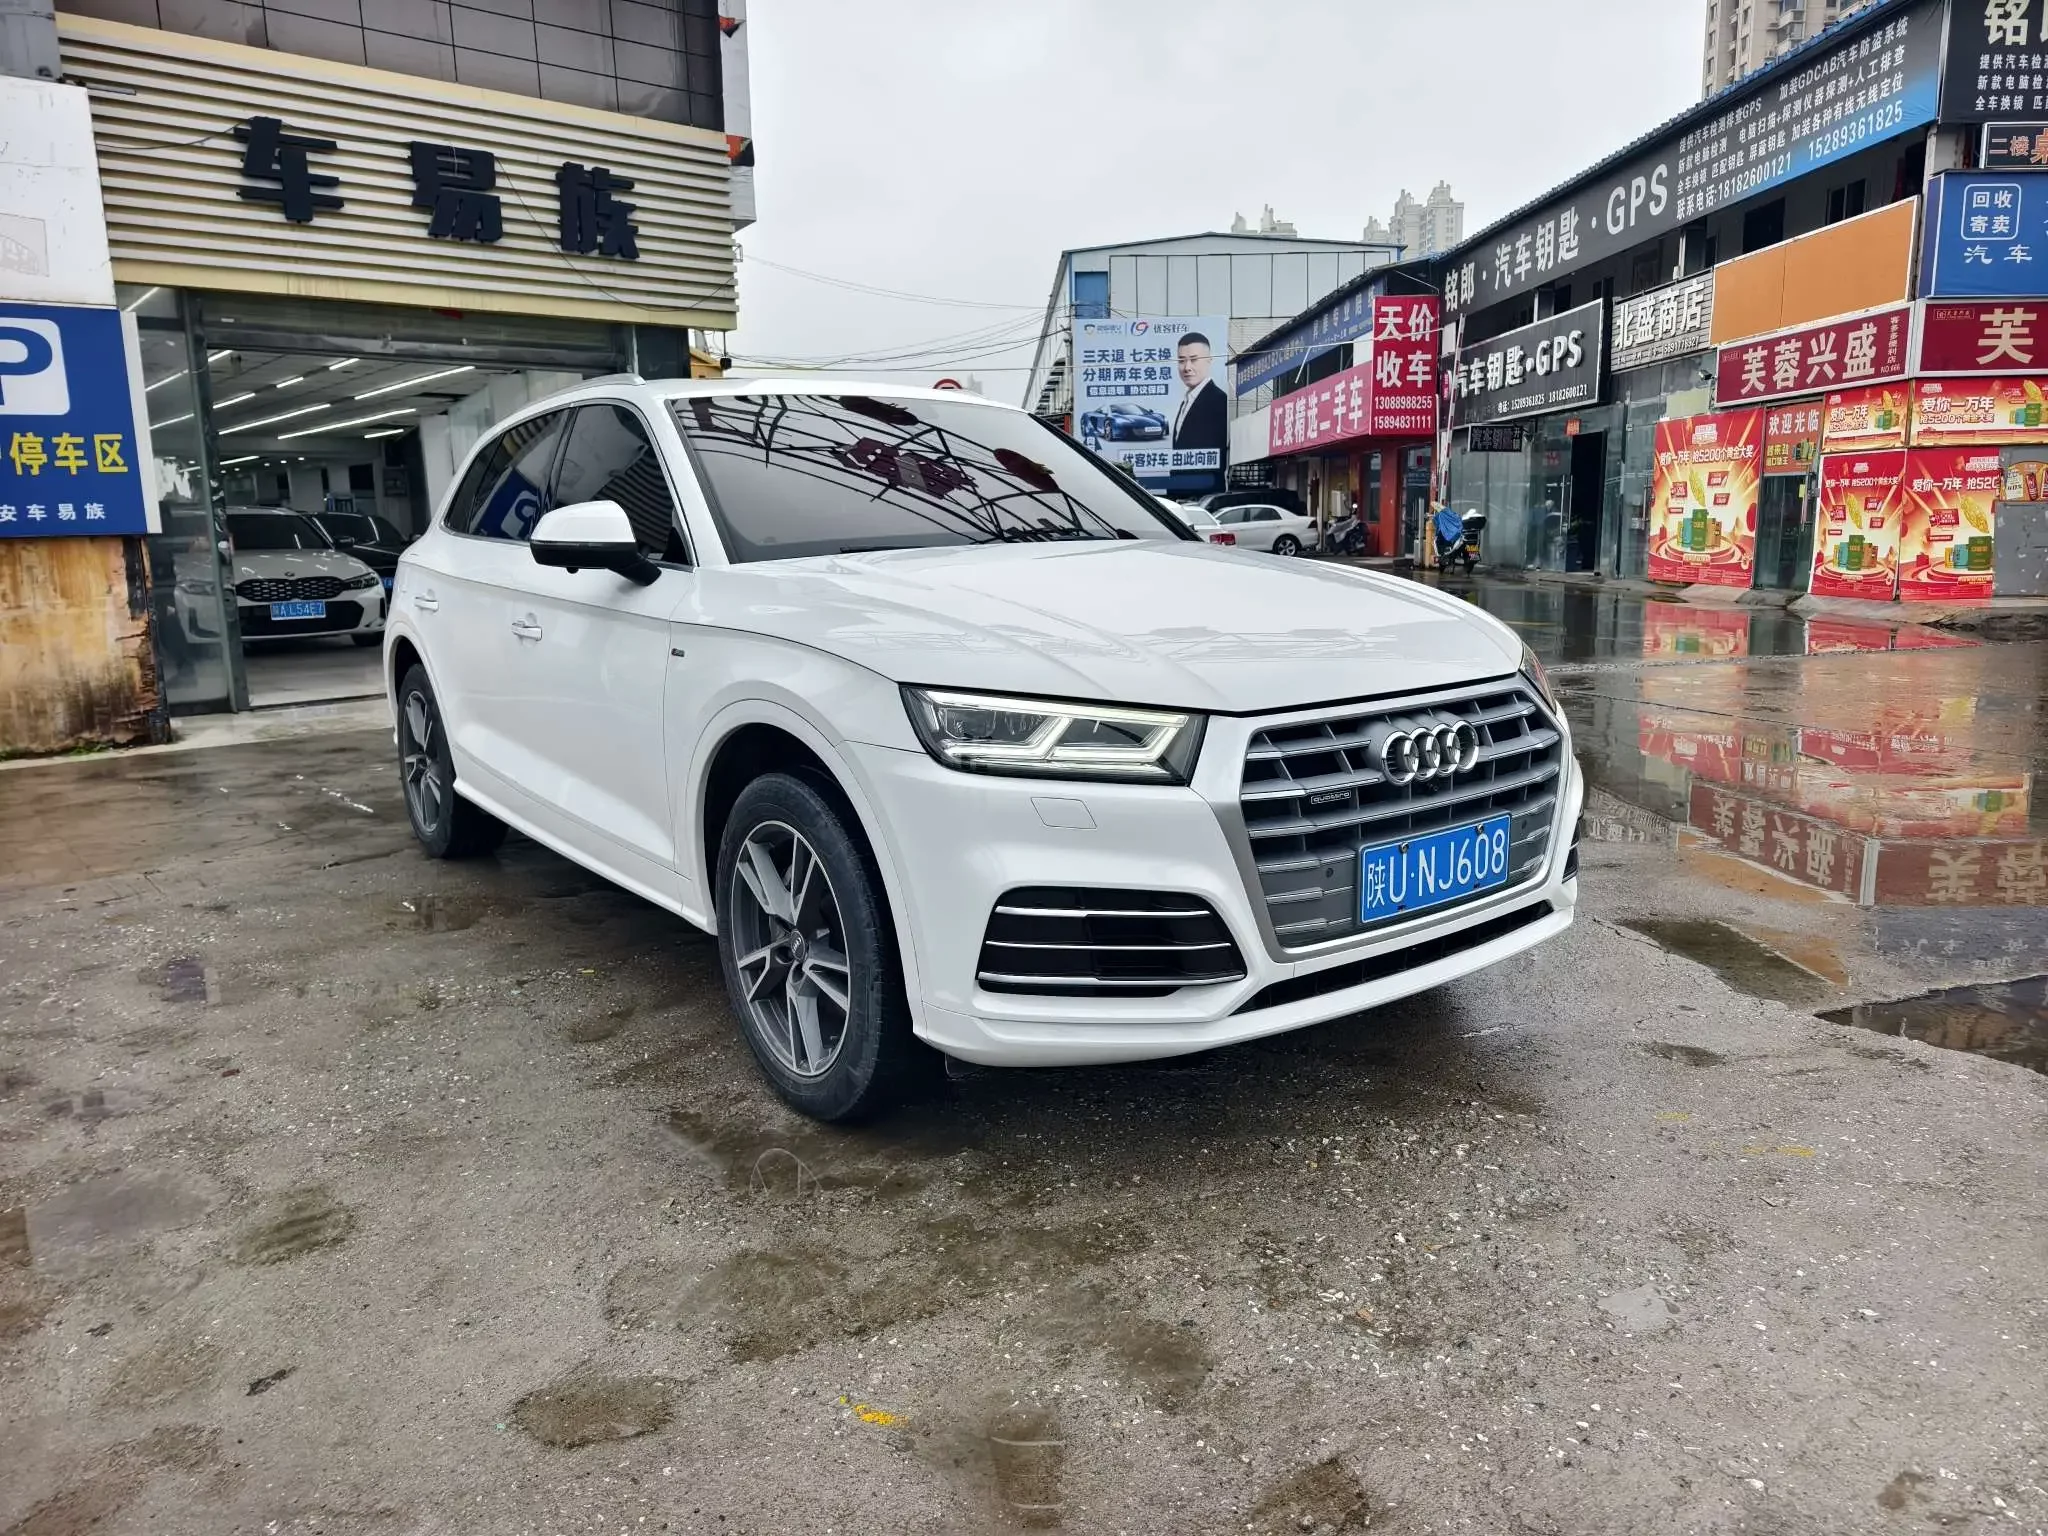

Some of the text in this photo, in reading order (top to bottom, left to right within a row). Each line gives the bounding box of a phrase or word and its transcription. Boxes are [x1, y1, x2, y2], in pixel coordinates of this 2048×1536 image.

[1984, 0, 2048, 45] 铭
[1779, 16, 1909, 101] 加装GDCAB汽车防盗系统
[1678, 45, 1905, 174] 新款电脑检测 电脑扫描+探测仪器探测+人工排查
[1791, 72, 1903, 141] 加装各种有线无线定位
[1809, 100, 1903, 161] 15289361825
[234, 116, 640, 259] 车易族
[1972, 190, 2013, 208] 回收
[1970, 215, 2010, 234] 寄卖
[1964, 244, 2033, 264] 汽车
[1378, 304, 1434, 342] 天价
[1615, 279, 1704, 349] 北盛商店
[1976, 307, 2038, 365] 芙
[1083, 348, 1172, 363] 三天退 七天换
[1083, 367, 1172, 381] 分期两年免息
[1376, 350, 1432, 388] 收车
[1740, 321, 1878, 395] 芙蓉兴盛
[1273, 376, 1364, 447] 汇聚精选二手车
[1375, 396, 1432, 410] 13088988255
[1768, 409, 1819, 435] 欢迎光临
[1921, 396, 1994, 413] 爱你一万年
[1374, 416, 1431, 430] 15894831111
[0, 432, 128, 476] 停车区
[1172, 451, 1218, 465] 由此向前
[1912, 476, 1963, 492] 爱你一万年
